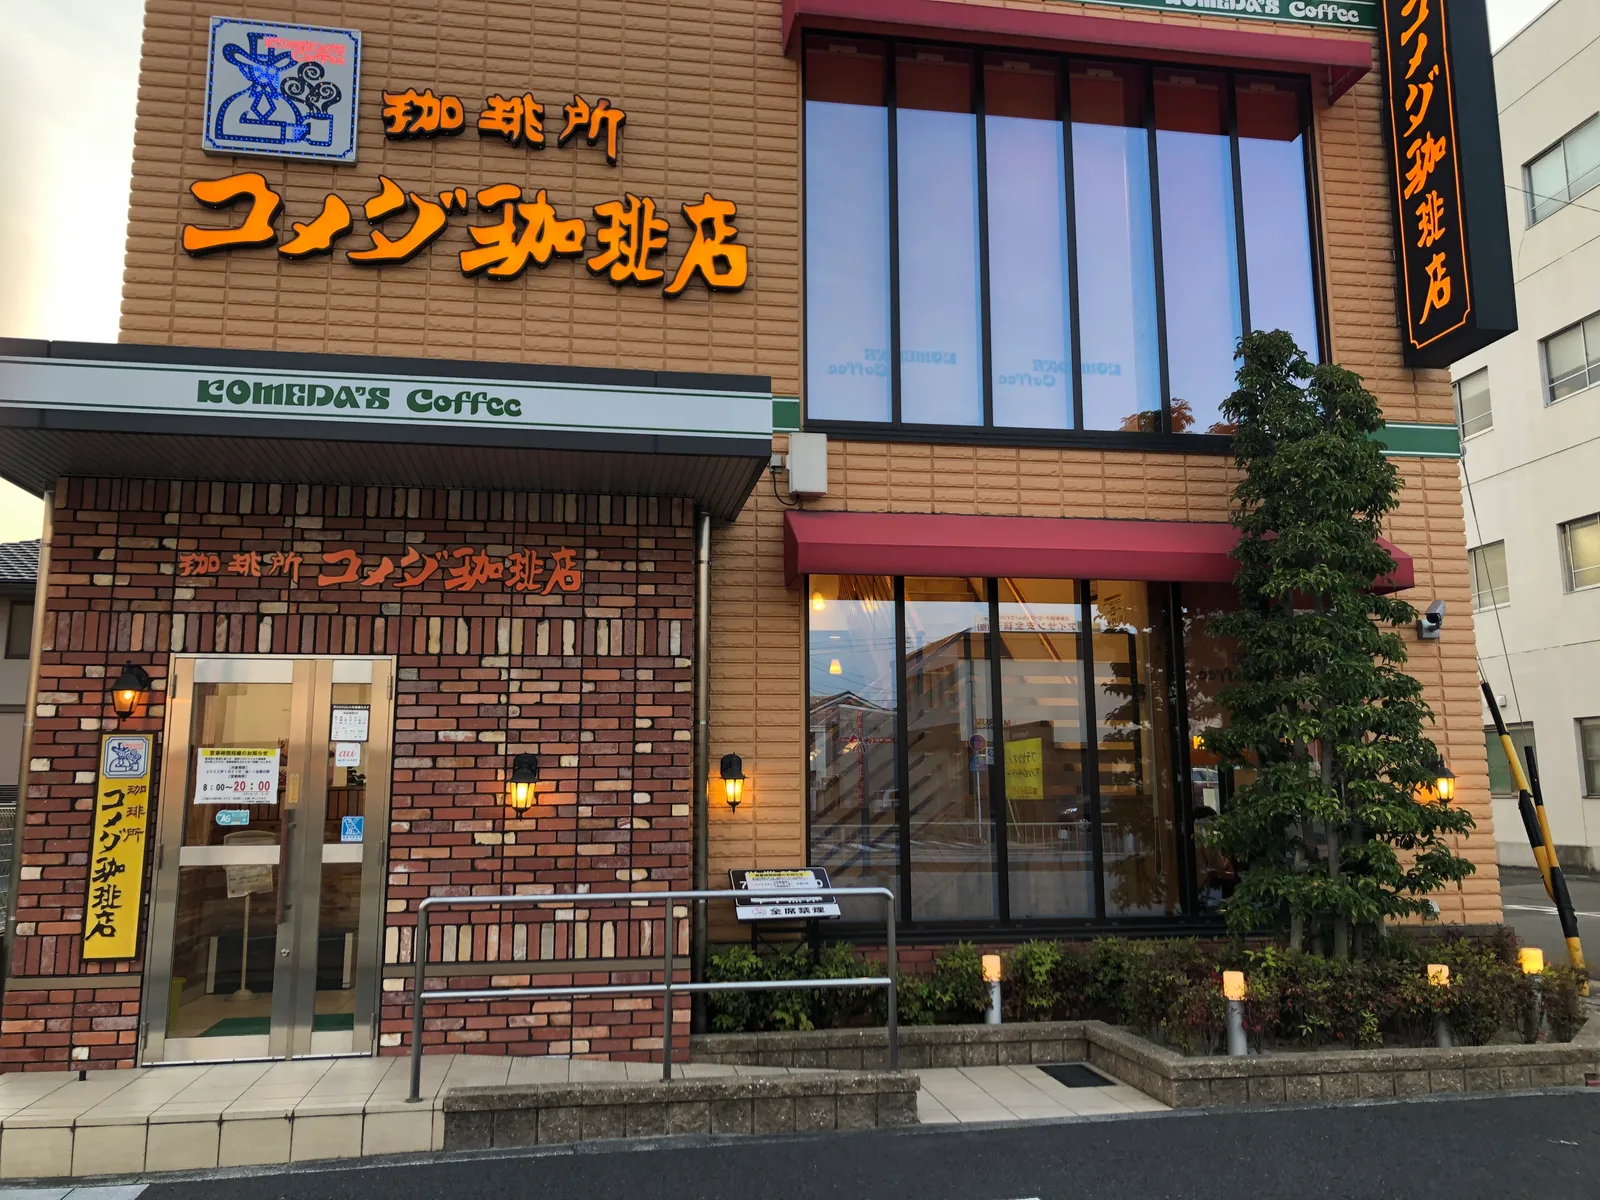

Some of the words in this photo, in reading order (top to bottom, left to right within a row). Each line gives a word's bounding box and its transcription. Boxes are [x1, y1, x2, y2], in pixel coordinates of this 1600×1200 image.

[1288, 0, 1360, 23] Coffee
[382, 88, 626, 166] 珈琲所
[182, 172, 749, 299] コメダ珈琲店
[197, 379, 390, 411] KOMEDA'S
[406, 388, 523, 418] Coffee
[177, 551, 304, 584] 珈琲所
[317, 545, 583, 595] コメダ珈琲店
[339, 750, 357, 758] au
[123, 784, 148, 843] 珈琲所
[85, 788, 127, 941] コメダ珈琲店
